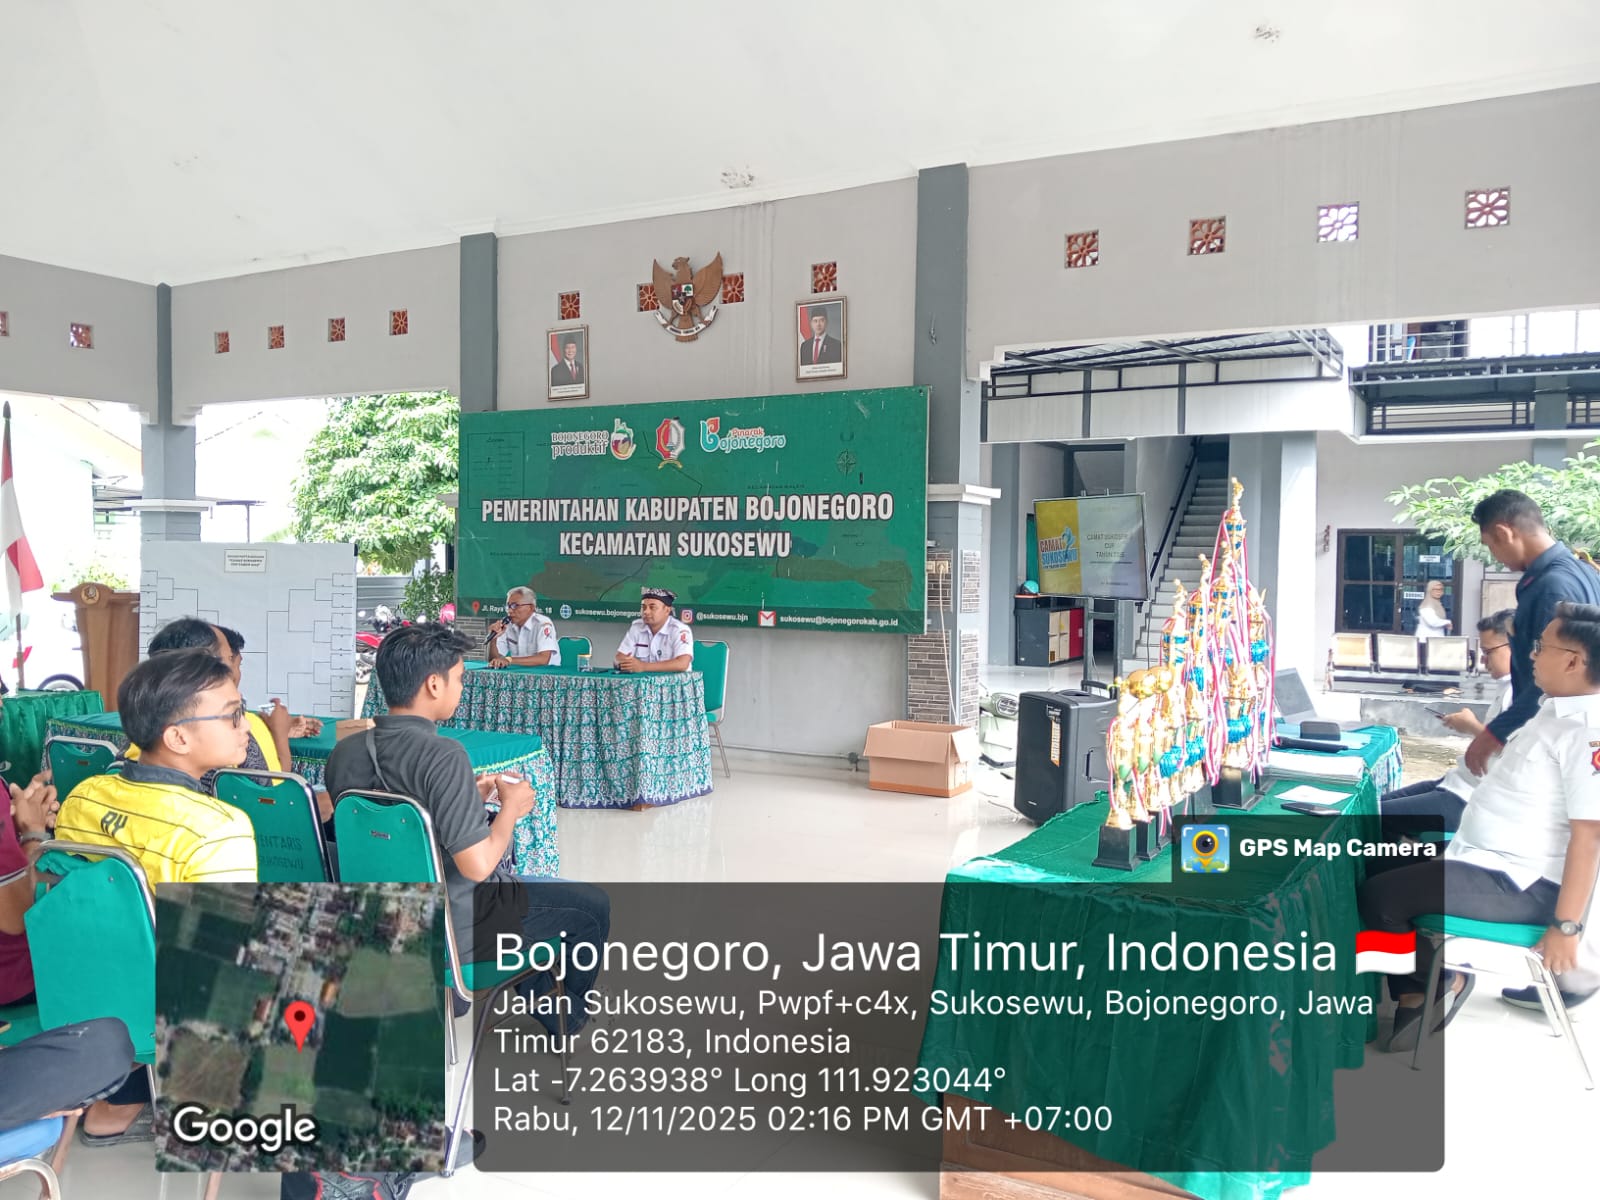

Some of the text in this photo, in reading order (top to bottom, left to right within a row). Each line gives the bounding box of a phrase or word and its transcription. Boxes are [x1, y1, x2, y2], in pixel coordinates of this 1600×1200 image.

[552, 431, 609, 442] BOJONEGORO
[552, 441, 608, 459] produktif
[481, 493, 894, 522] PEMERINTAHAN KABUPATEN BOJONEGORO
[559, 531, 791, 557] KECAMATAN SUKOSEWU
[490, 605, 504, 614] Raya
[575, 608, 641, 619] sukosewu.bojonegoro
[696, 612, 748, 622] @sukosewu.bjn
[780, 614, 898, 627] sukosewu@bojonegorokab.go.id
